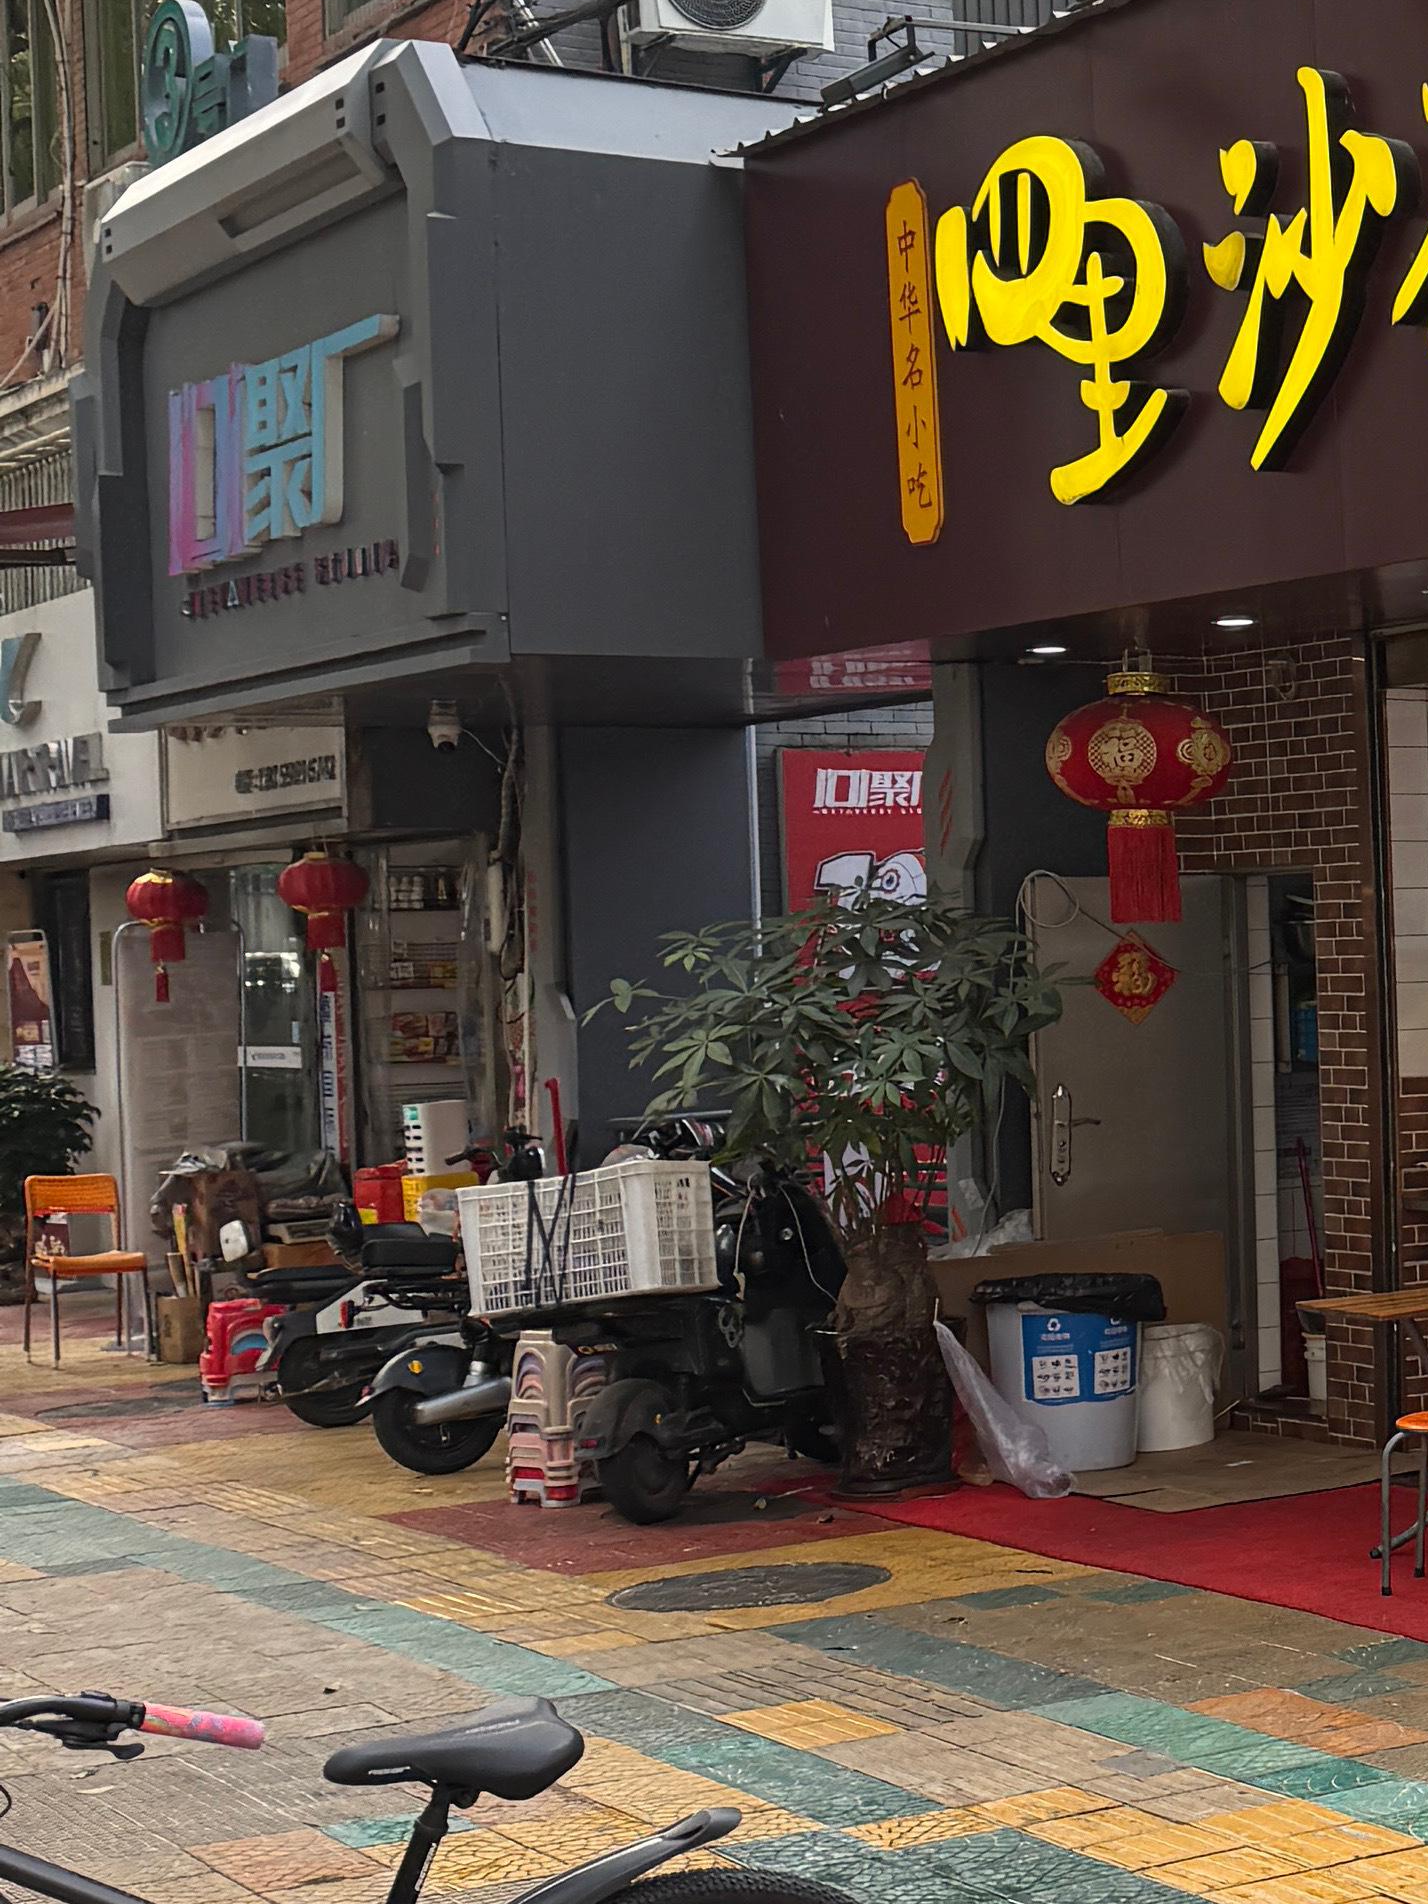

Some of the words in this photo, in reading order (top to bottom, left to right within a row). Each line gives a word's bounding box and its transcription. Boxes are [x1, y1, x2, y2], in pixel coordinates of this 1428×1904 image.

[898, 220, 933, 509] 中华名小吃
